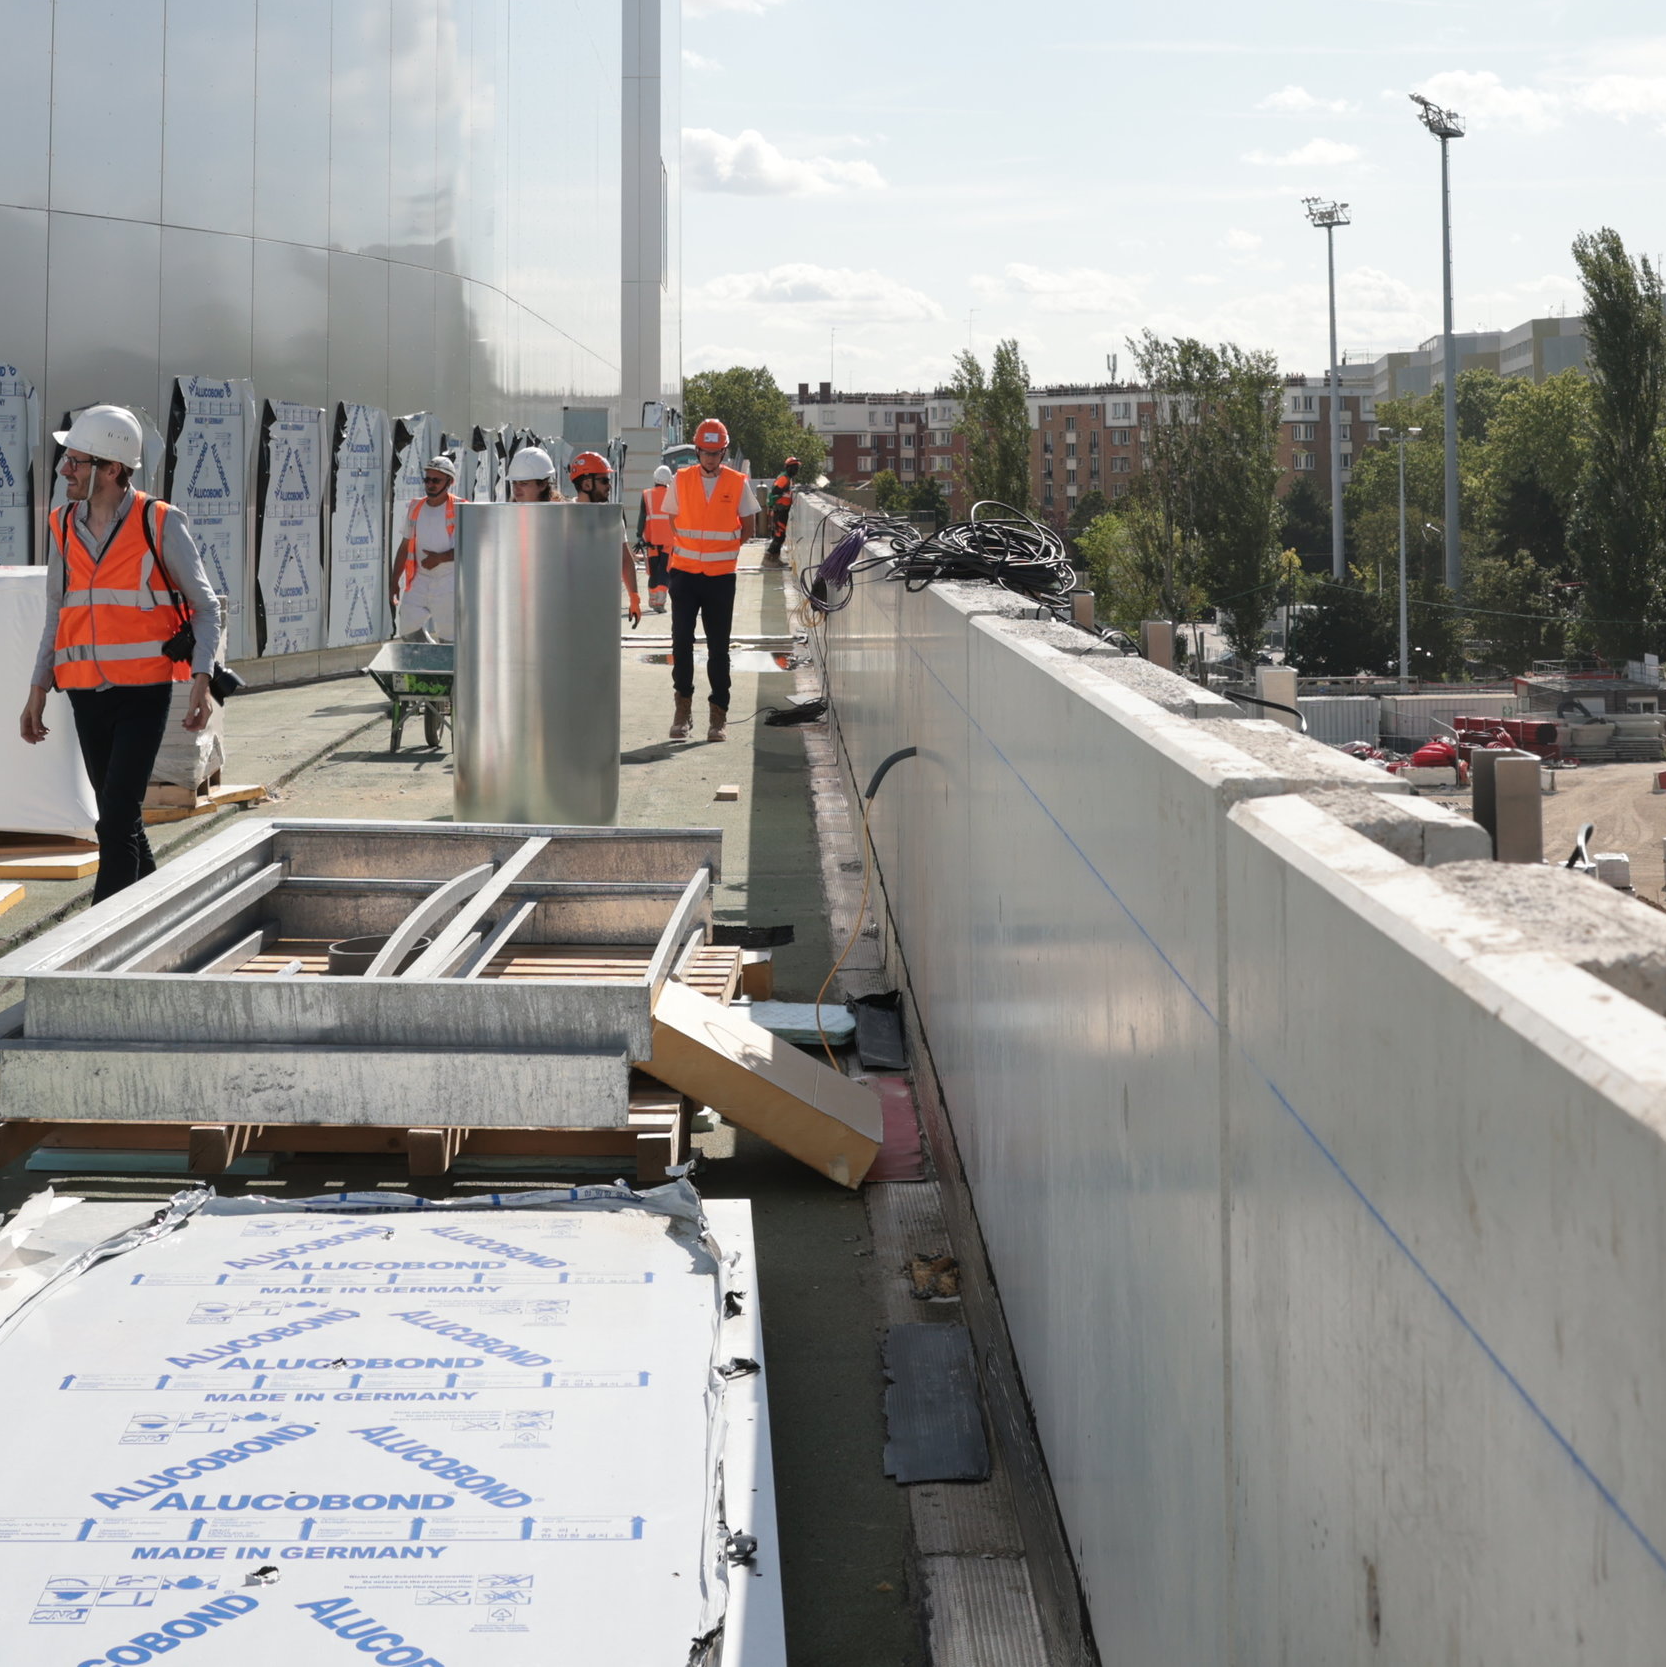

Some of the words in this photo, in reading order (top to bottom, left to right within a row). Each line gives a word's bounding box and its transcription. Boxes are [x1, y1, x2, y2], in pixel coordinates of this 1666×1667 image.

[223, 1225, 395, 1270] ALUCOBOND
[269, 1261, 507, 1270] ALUCOBOND
[420, 1226, 567, 1269] ALUCOBOND
[374, 1286, 504, 1294] GERMANY
[165, 1309, 361, 1369] ALUCOBOND
[388, 1310, 552, 1368] ALUCOBOND
[205, 1393, 287, 1402] MADE
[294, 1393, 324, 1402] IN
[331, 1392, 480, 1402] GERMANY
[90, 1424, 317, 1510] ALUCOBOND
[348, 1425, 532, 1509] ALUCOBOND
[149, 1493, 455, 1511] ALUCOBOND
[131, 1547, 227, 1559] MADE
[235, 1547, 270, 1559] IN
[280, 1546, 449, 1559] GERMANY
